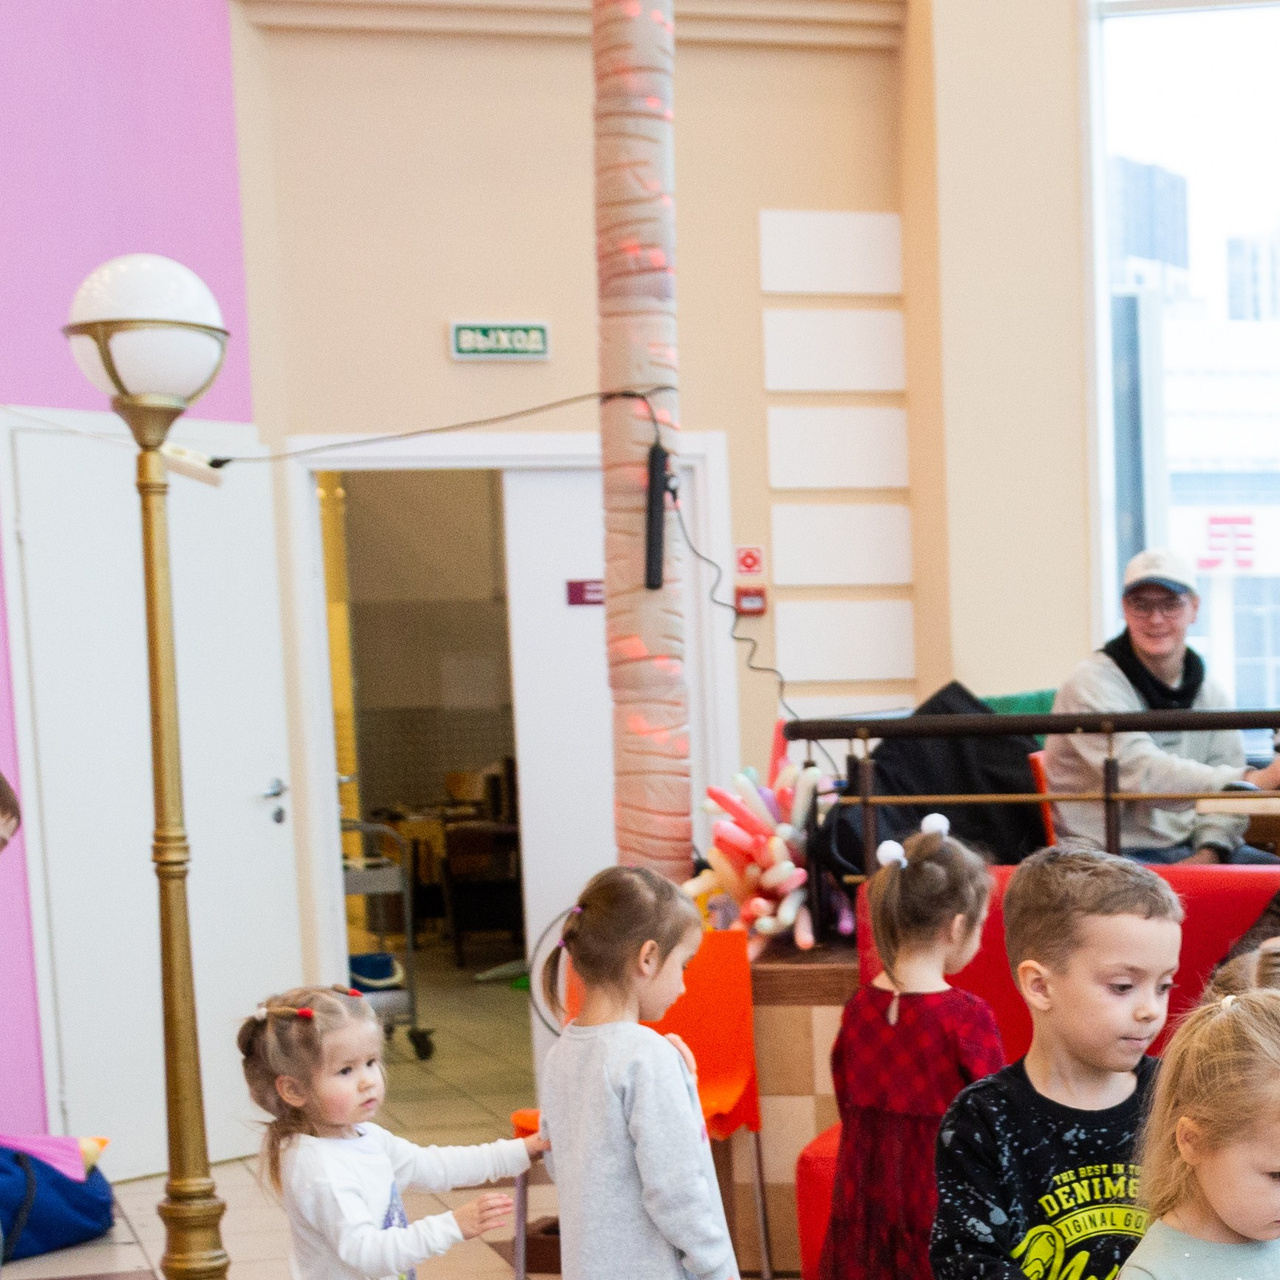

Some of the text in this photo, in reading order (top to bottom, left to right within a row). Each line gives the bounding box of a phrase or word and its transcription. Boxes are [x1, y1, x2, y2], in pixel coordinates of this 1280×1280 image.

[459, 328, 543, 350] ВЫХОД
[1053, 1170, 1076, 1185] THE
[1078, 1164, 1109, 1177] BEST
[1112, 1164, 1125, 1174] IN
